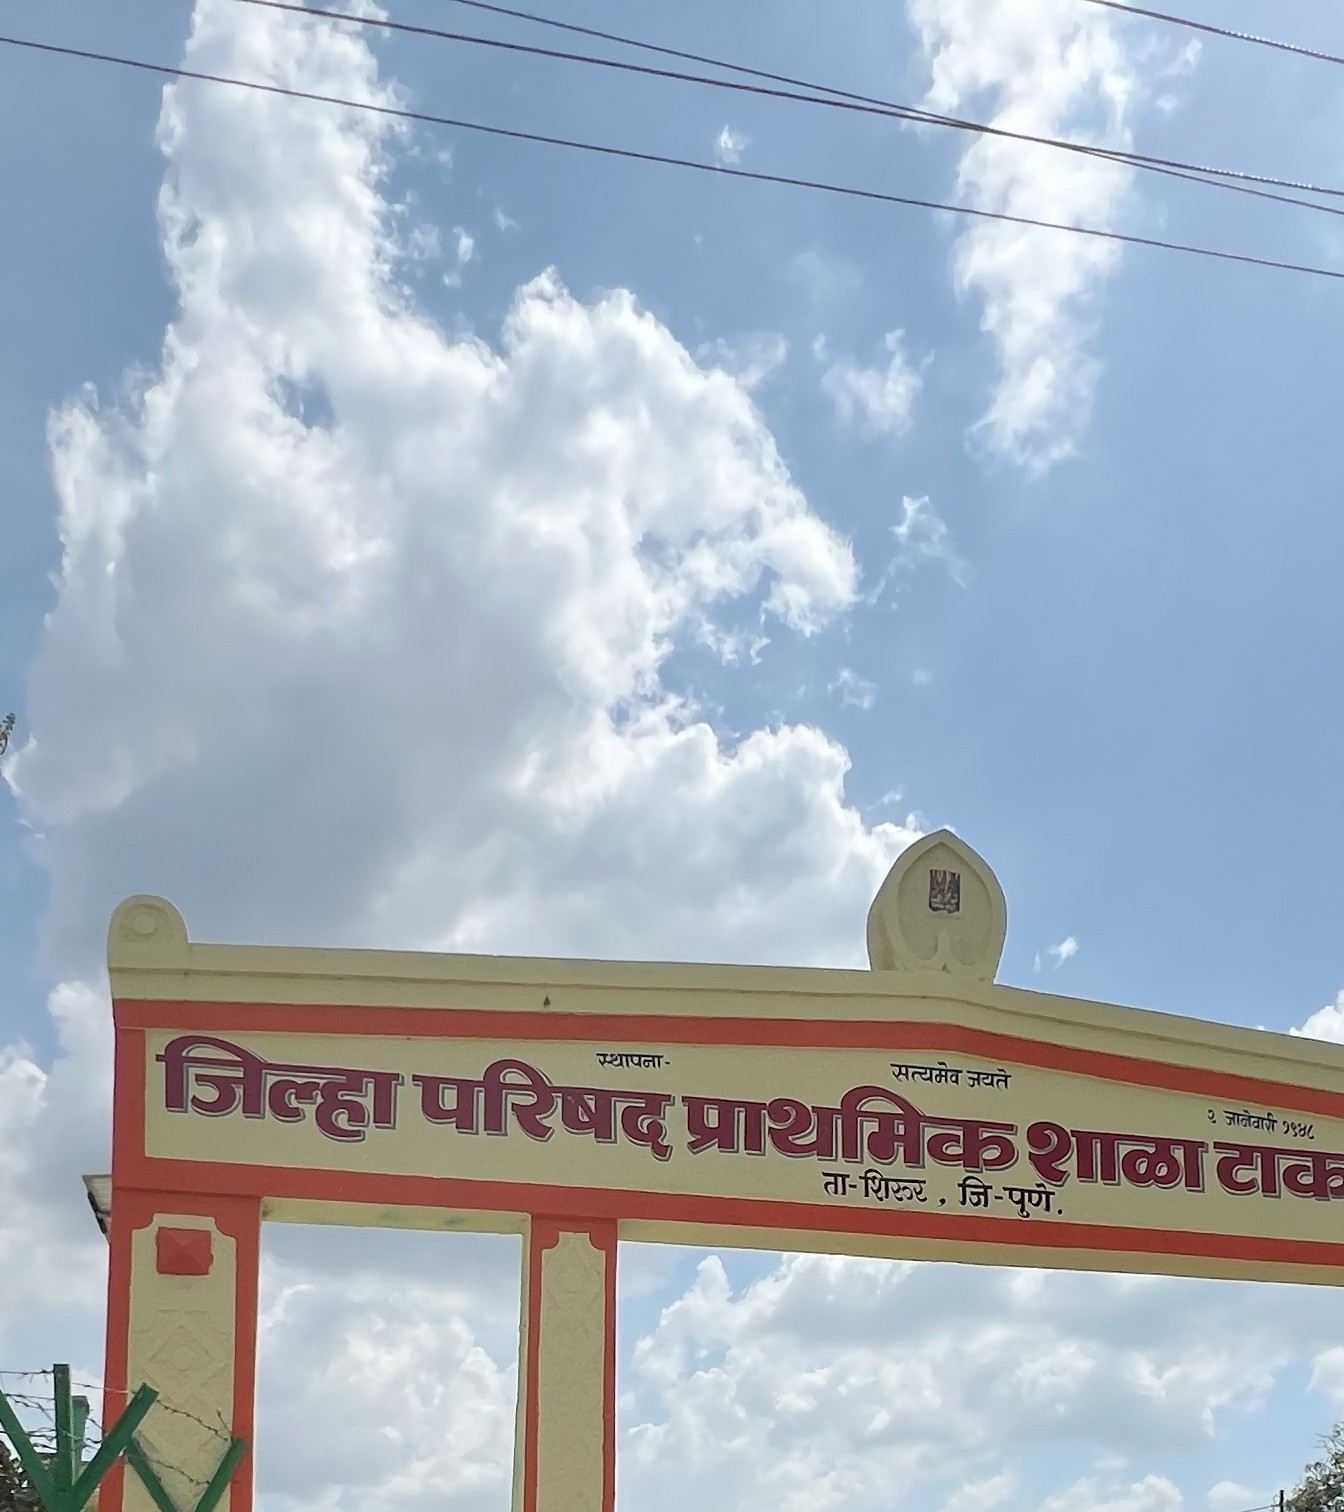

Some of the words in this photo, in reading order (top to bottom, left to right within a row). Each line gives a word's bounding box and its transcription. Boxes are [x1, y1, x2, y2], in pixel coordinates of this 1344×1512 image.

[889, 1060, 963, 1087] सत्यमेव
[966, 1067, 1012, 1091] जयते
[155, 1034, 403, 1142] जिल्हा
[412, 1058, 672, 1160] परिषद
[681, 1084, 1018, 1174] प्राथमिक
[1025, 1120, 1208, 1193] शाळा
[1222, 1108, 1278, 1134] जानेवारी
